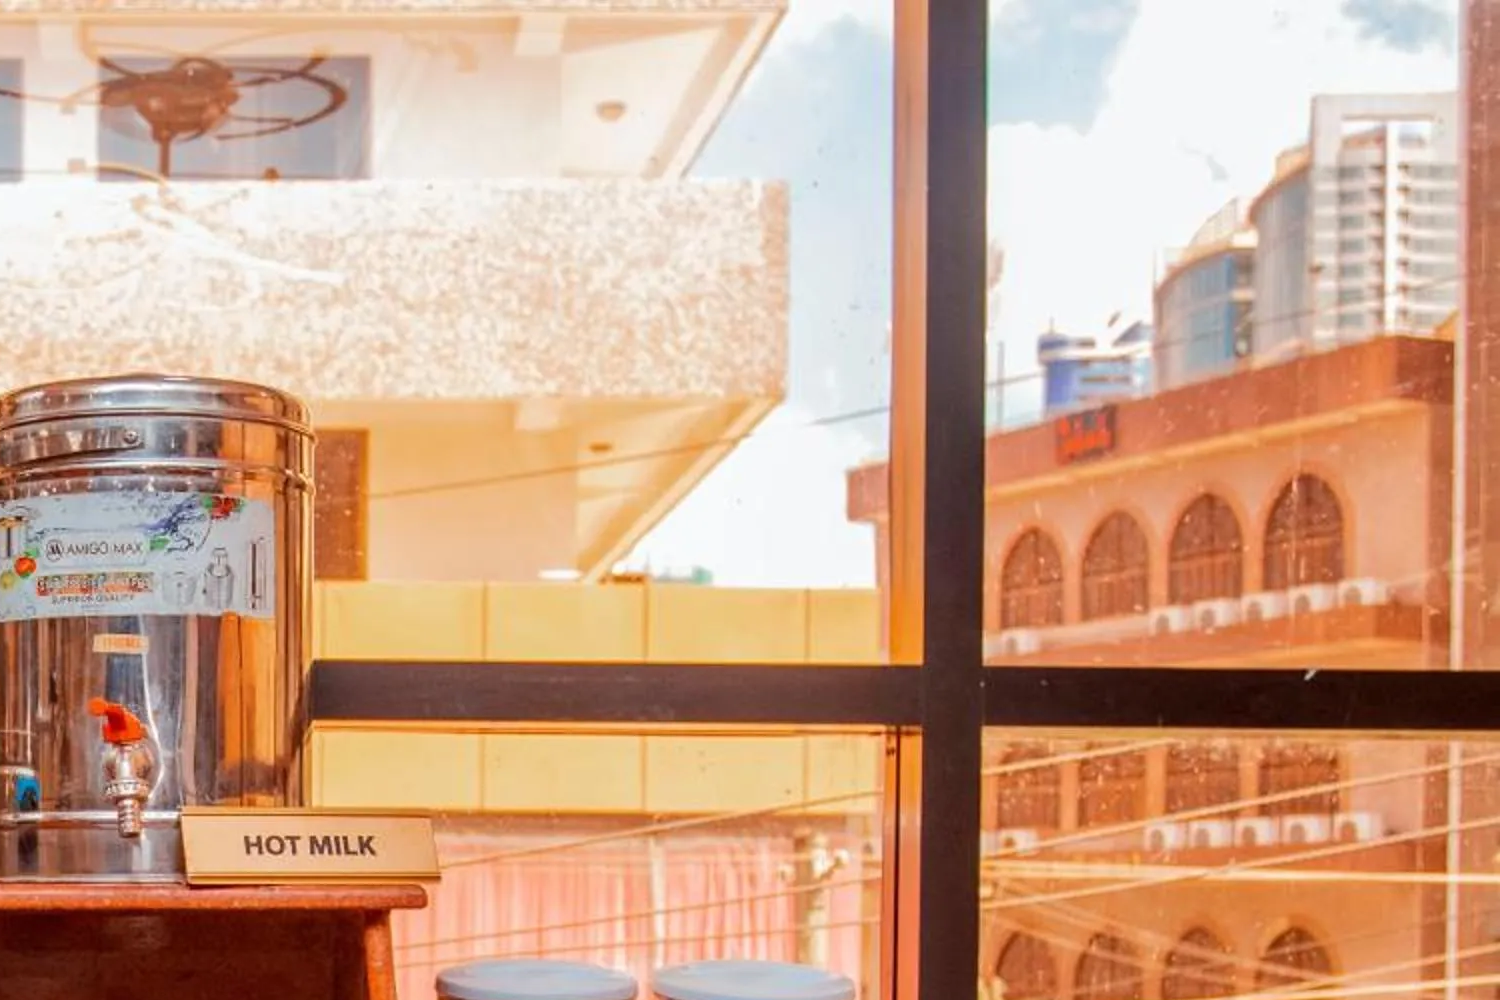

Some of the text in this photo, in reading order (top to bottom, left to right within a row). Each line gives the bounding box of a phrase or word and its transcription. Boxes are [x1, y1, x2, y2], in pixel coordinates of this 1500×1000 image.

[67, 541, 109, 555] AMIGO
[113, 541, 142, 555] MAX
[243, 835, 378, 856] HOT MILK
